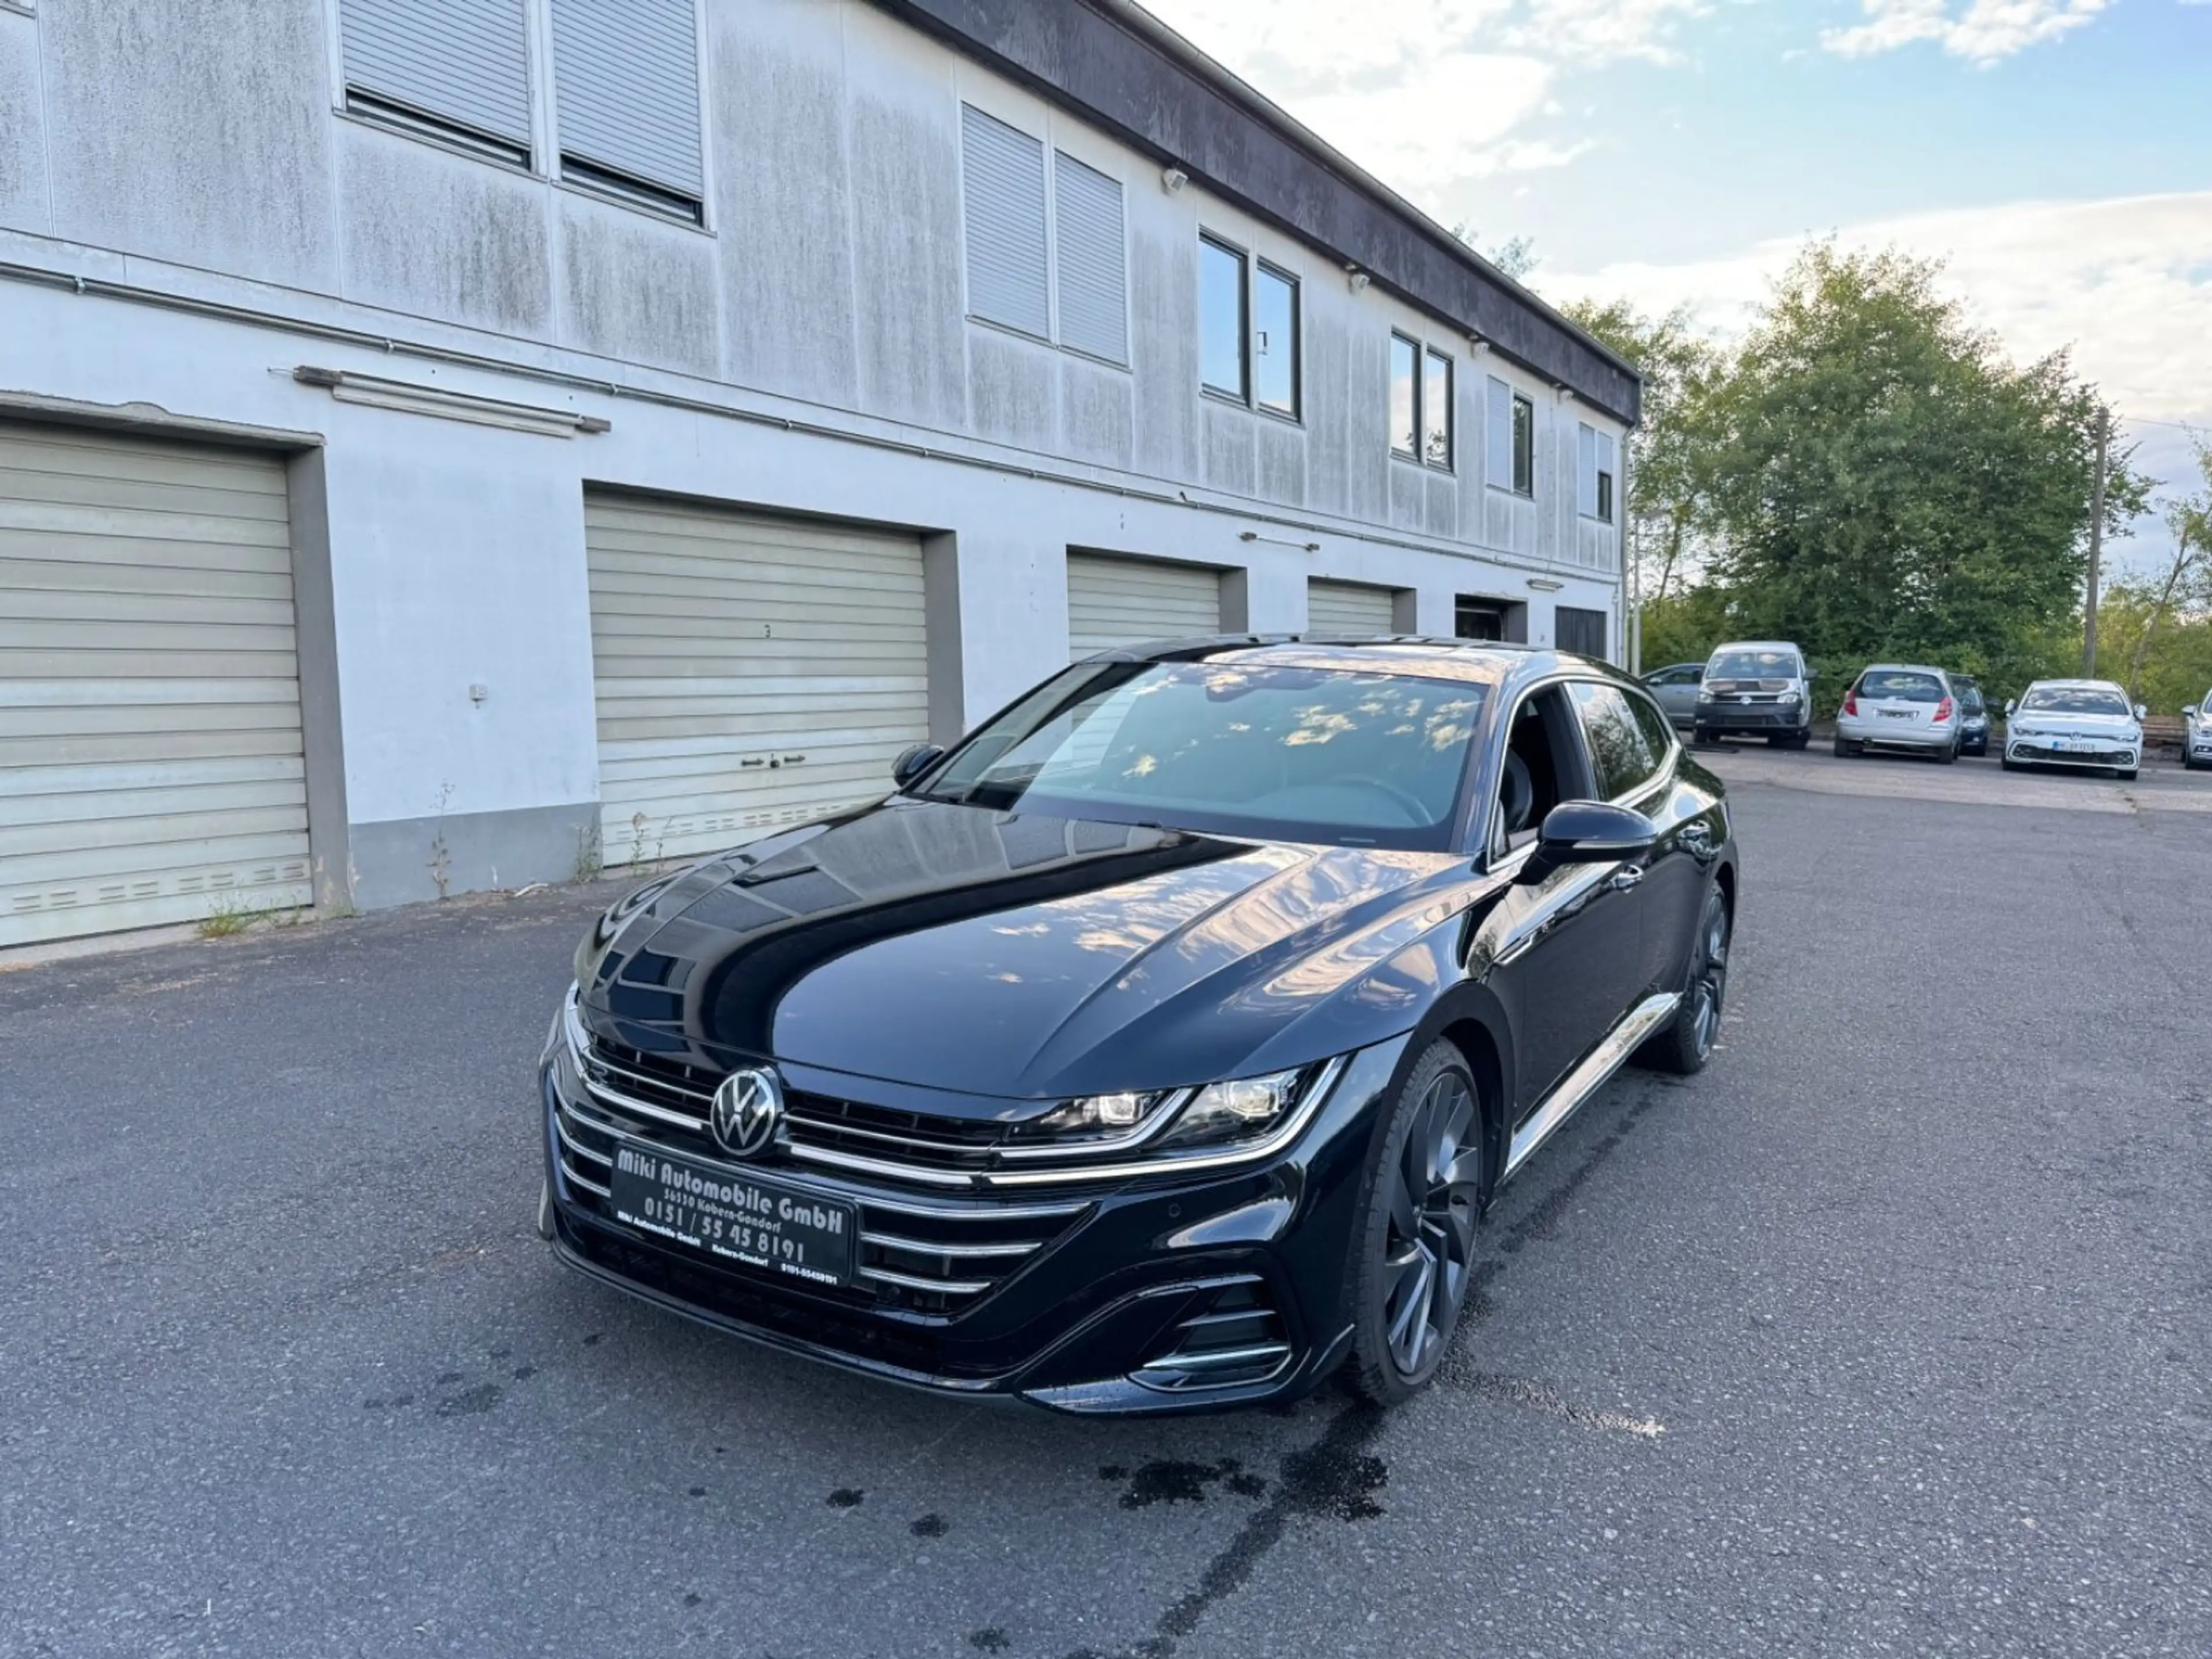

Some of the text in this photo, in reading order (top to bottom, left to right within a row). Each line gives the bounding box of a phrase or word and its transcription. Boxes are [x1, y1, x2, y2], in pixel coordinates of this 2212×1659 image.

[618, 1149, 842, 1234] Miki Automobile GmbH
[697, 1198, 782, 1233] Kobern-Gondorf
[634, 1216, 676, 1238] Automobile
[644, 1197, 804, 1263] 0151 / 55 45 8191
